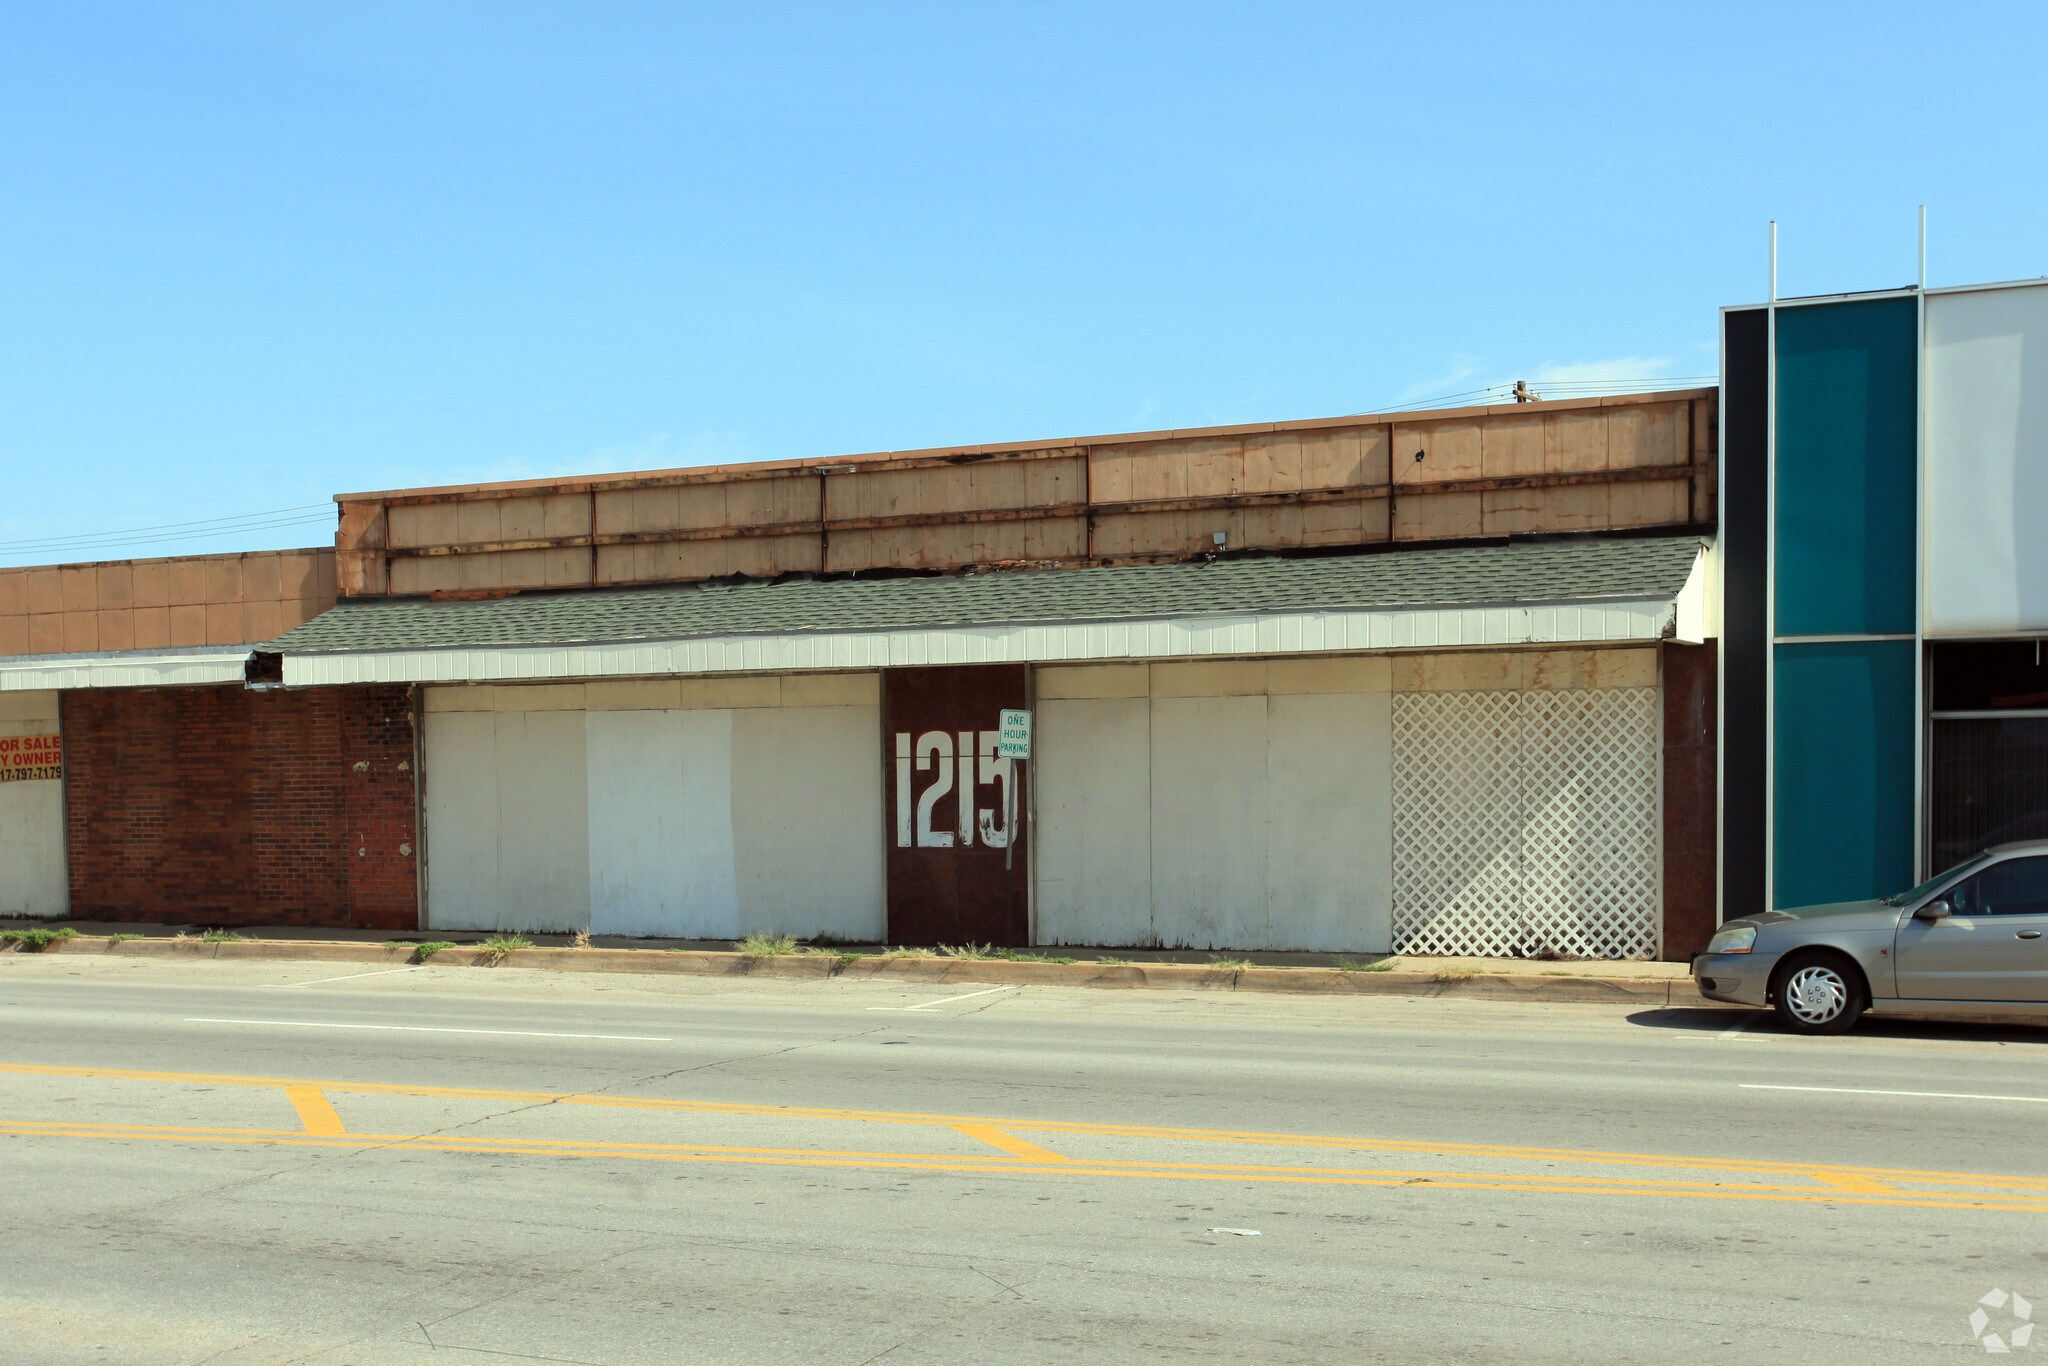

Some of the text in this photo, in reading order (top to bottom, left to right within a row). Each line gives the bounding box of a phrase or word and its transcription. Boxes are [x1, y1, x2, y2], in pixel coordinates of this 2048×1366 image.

[1007, 716, 1025, 726] ONE
[1004, 730, 1027, 739] HOUR
[24, 736, 61, 750] SALE
[1000, 743, 1028, 753] PARKING
[13, 752, 61, 766] OWNER
[896, 731, 1018, 848] 1215
